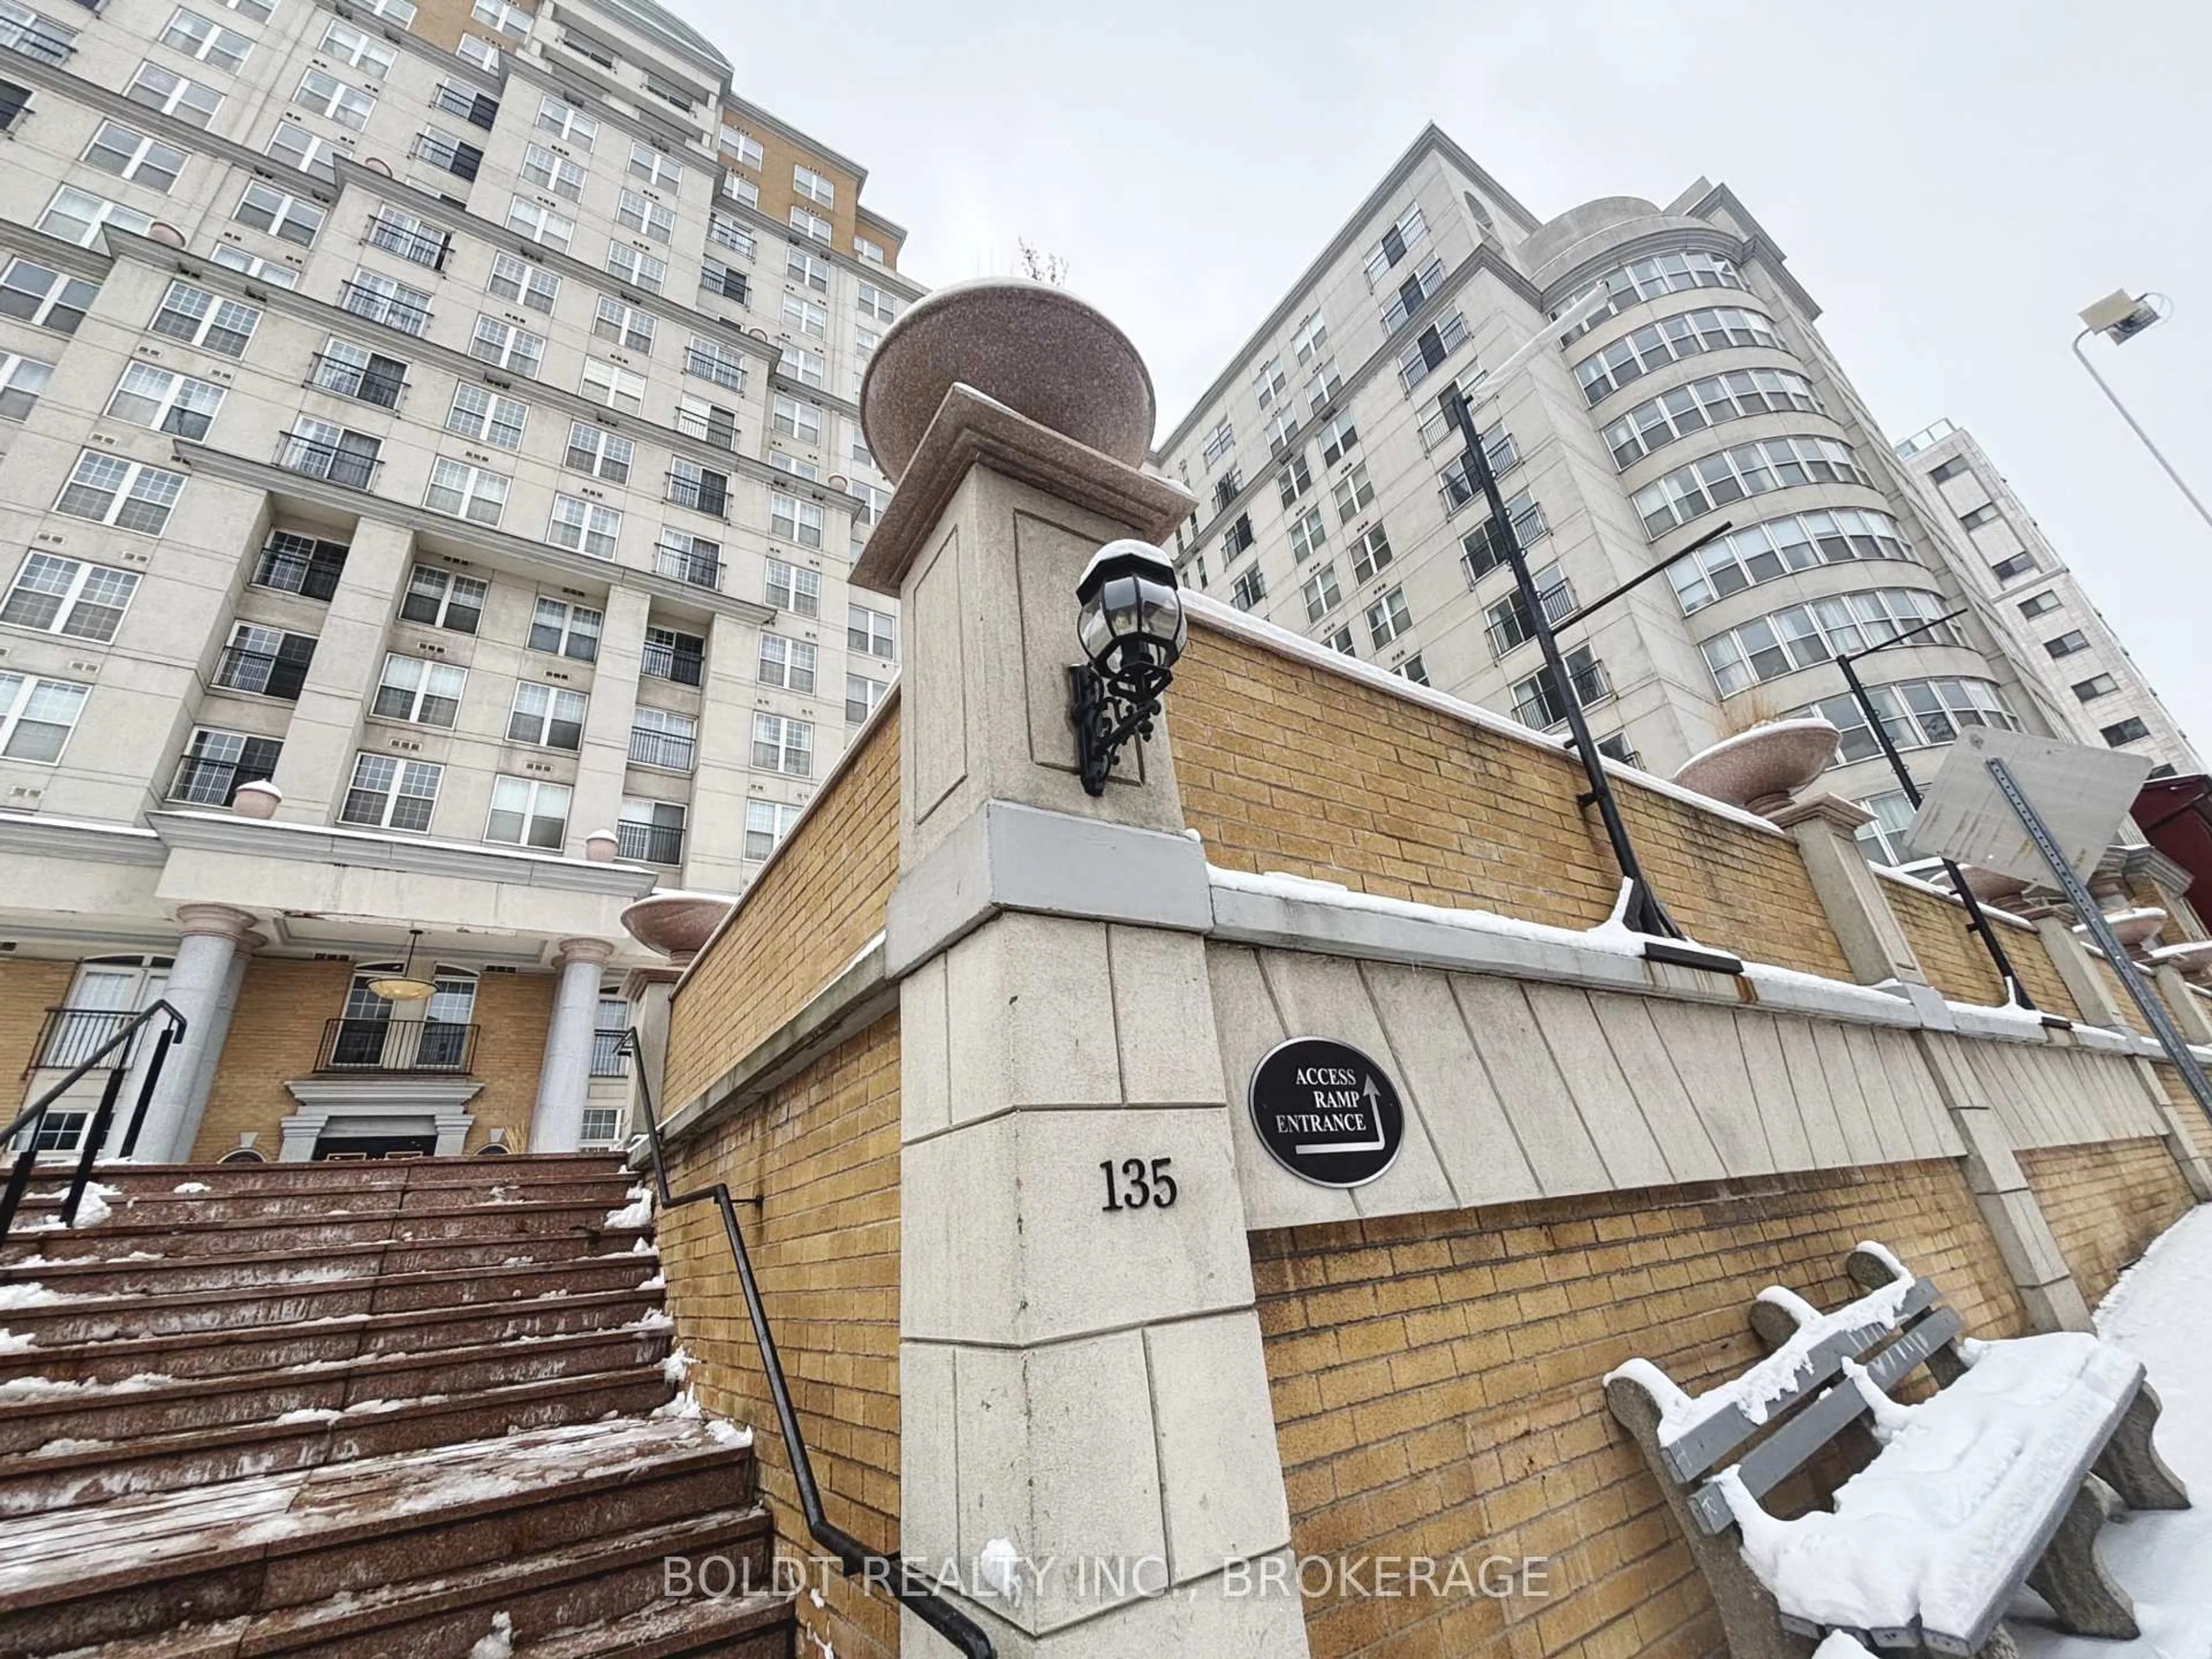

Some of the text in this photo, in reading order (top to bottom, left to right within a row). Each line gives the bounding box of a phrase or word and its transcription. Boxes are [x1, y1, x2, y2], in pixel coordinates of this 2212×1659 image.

[1296, 1067, 1357, 1085] ACCESS
[1313, 1090, 1360, 1108] RAMP
[1275, 1113, 1366, 1134] ENTRANCE
[1099, 1157, 1177, 1212] 135
